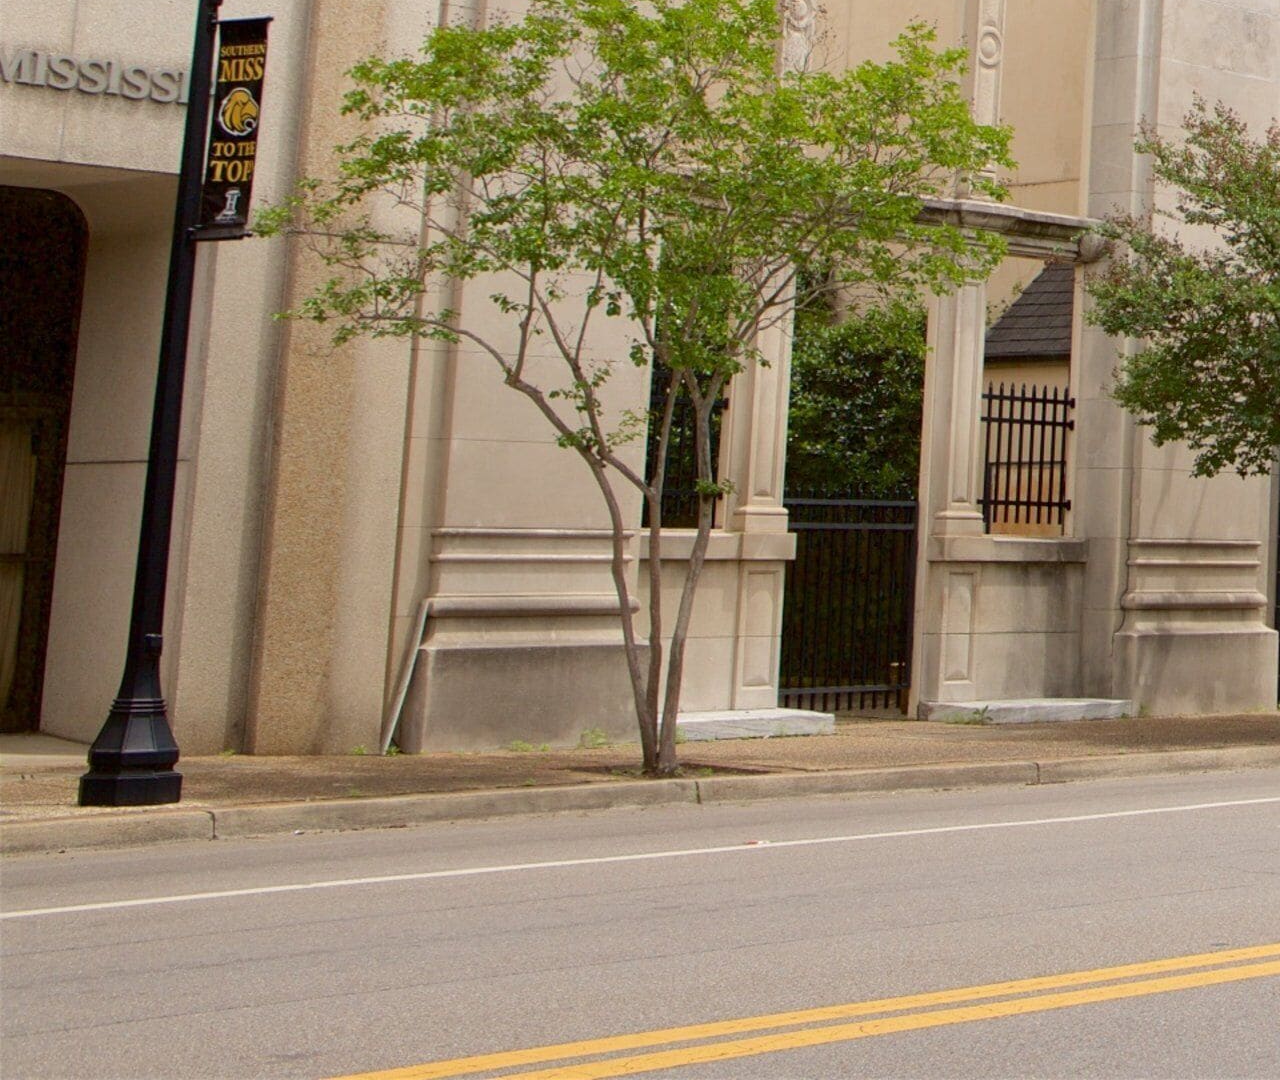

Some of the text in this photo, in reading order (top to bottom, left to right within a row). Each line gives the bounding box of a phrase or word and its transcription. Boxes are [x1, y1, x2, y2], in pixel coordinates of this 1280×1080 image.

[220, 44, 266, 57] SOUTHERN
[0, 44, 190, 105] MISSISSI
[219, 57, 264, 83] MISS
[212, 141, 257, 157] TO THE
